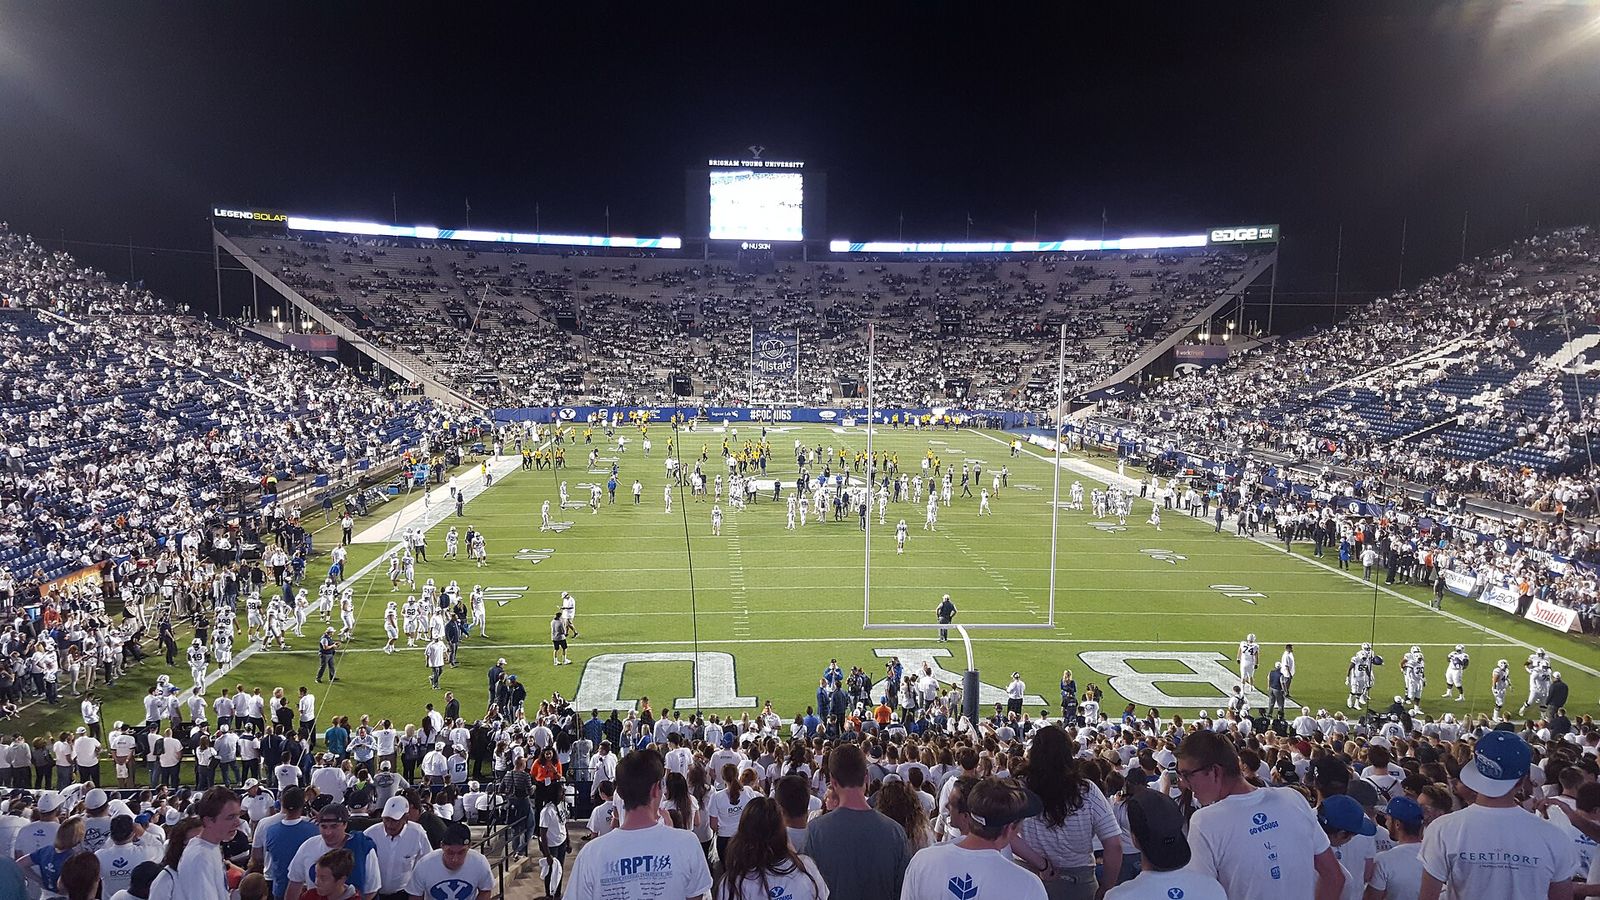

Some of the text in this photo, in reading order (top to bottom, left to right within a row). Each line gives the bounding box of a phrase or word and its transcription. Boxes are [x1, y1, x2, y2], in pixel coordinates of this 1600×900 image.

[757, 360, 792, 370] Allstate
[1496, 592, 1517, 607] BOX
[1242, 645, 1254, 655] 74
[728, 806, 742, 814] BOX
[1460, 852, 1540, 865] CERTIPORT
[620, 855, 654, 876] RPT
[110, 869, 131, 877] BOX
